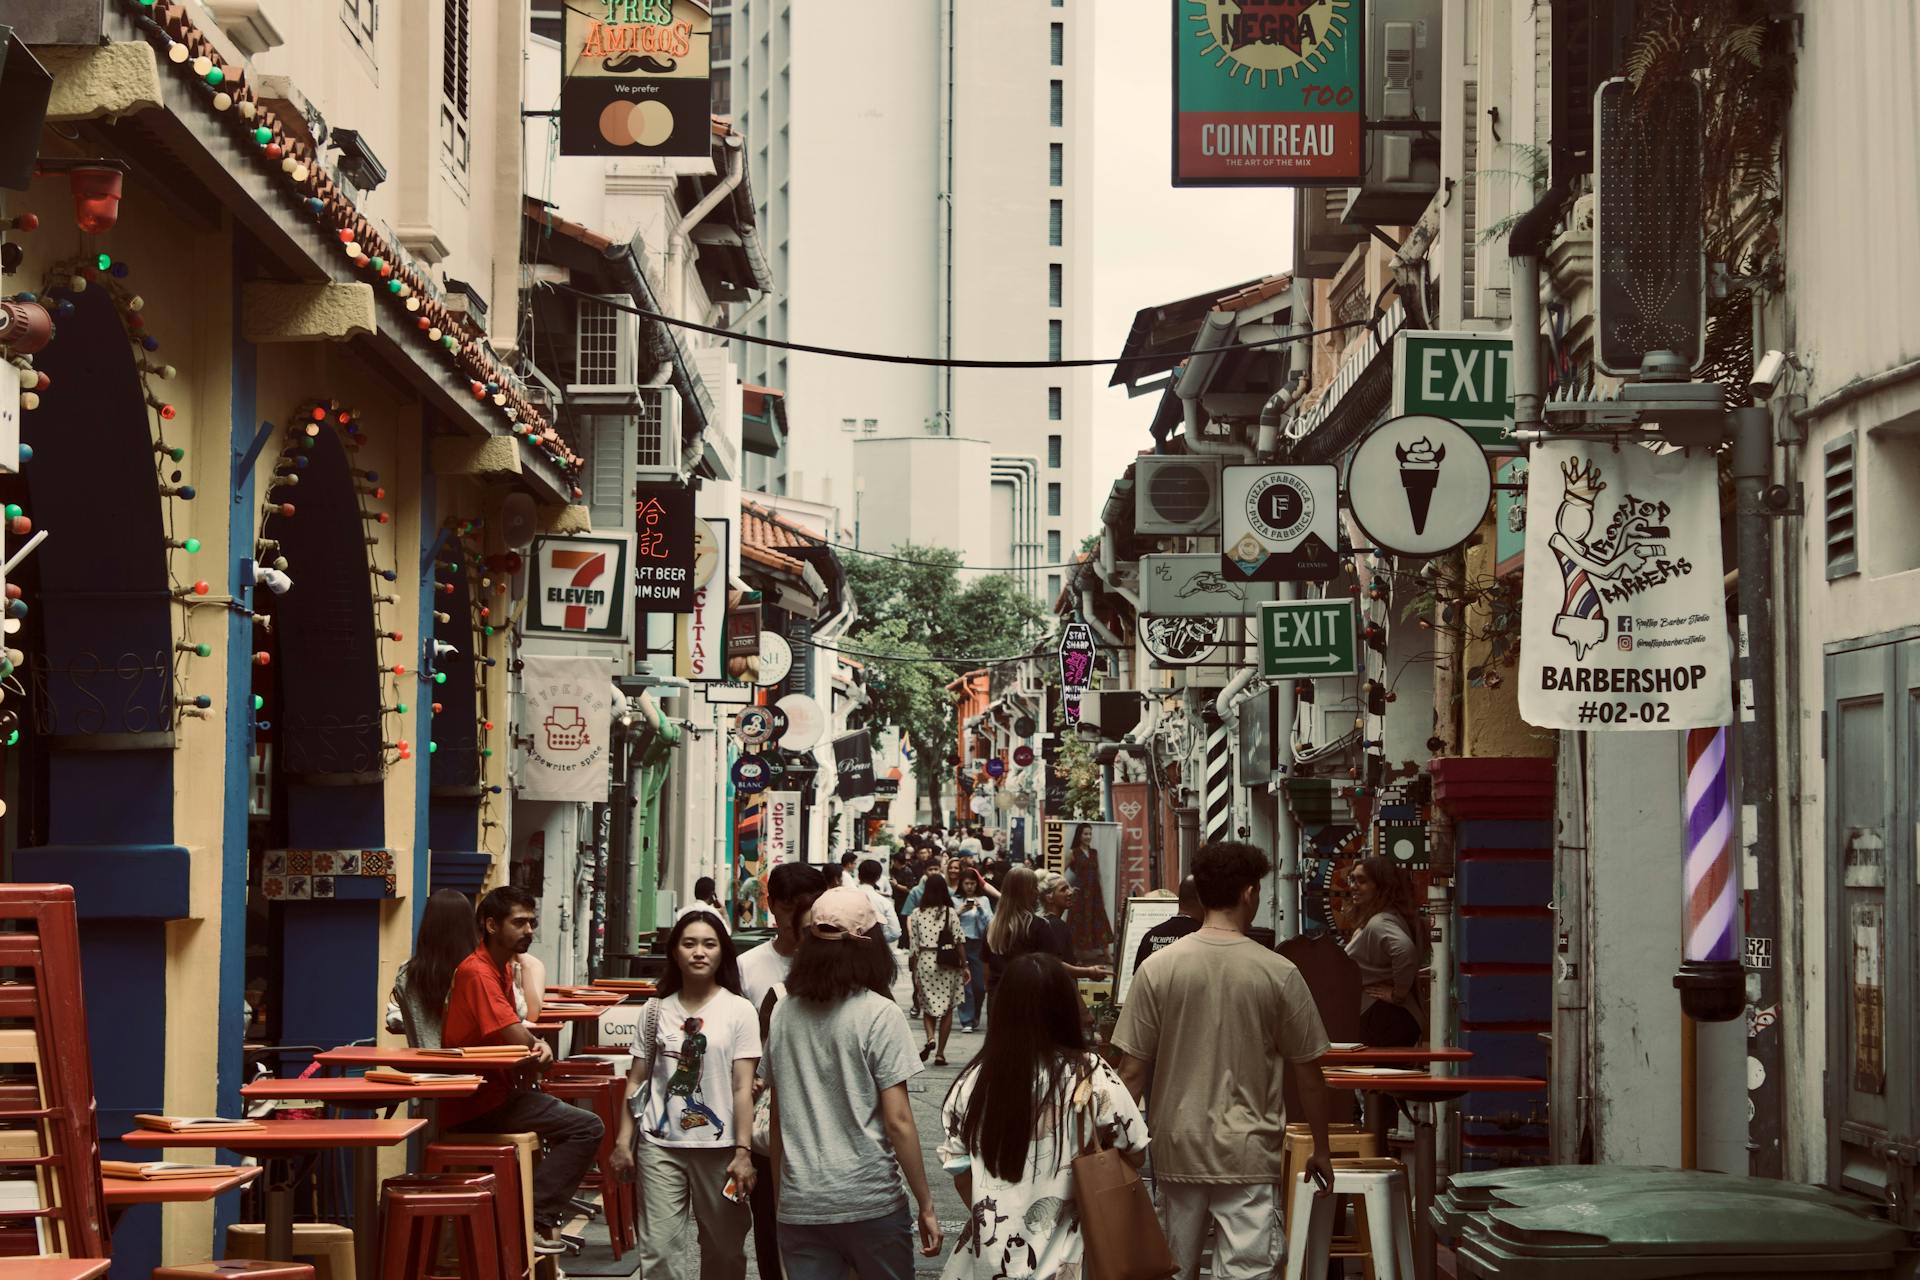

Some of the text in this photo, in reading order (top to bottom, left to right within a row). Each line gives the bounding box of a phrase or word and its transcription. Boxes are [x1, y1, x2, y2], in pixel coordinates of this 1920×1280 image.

[602, 0, 674, 25] TRES
[581, 21, 690, 57] AMIGOS
[1221, 13, 1317, 45] NEGRA
[614, 84, 660, 95] We prefer
[1201, 123, 1334, 156] COINTREAU
[1421, 347, 1514, 404] EXIT
[1249, 475, 1312, 505] PIZZA FABBRICA
[1271, 494, 1289, 520] F
[1249, 510, 1312, 539] PIZZA FABBRICA
[655, 567, 686, 581] BEER
[1155, 562, 1172, 581] 吃
[653, 586, 680, 599] SUM
[691, 586, 708, 675] CITAS
[1068, 631, 1087, 640] STAY
[1273, 610, 1341, 648] EXIT
[1660, 616, 1687, 629] Barber
[1066, 641, 1090, 650] SHARP
[1541, 664, 1707, 693] BARBERSHOP
[1578, 702, 1670, 724] #02-02
[580, 745, 602, 767] space
[786, 802, 795, 817] WAX
[772, 802, 784, 849] Studio
[1127, 827, 1145, 893] PINK
